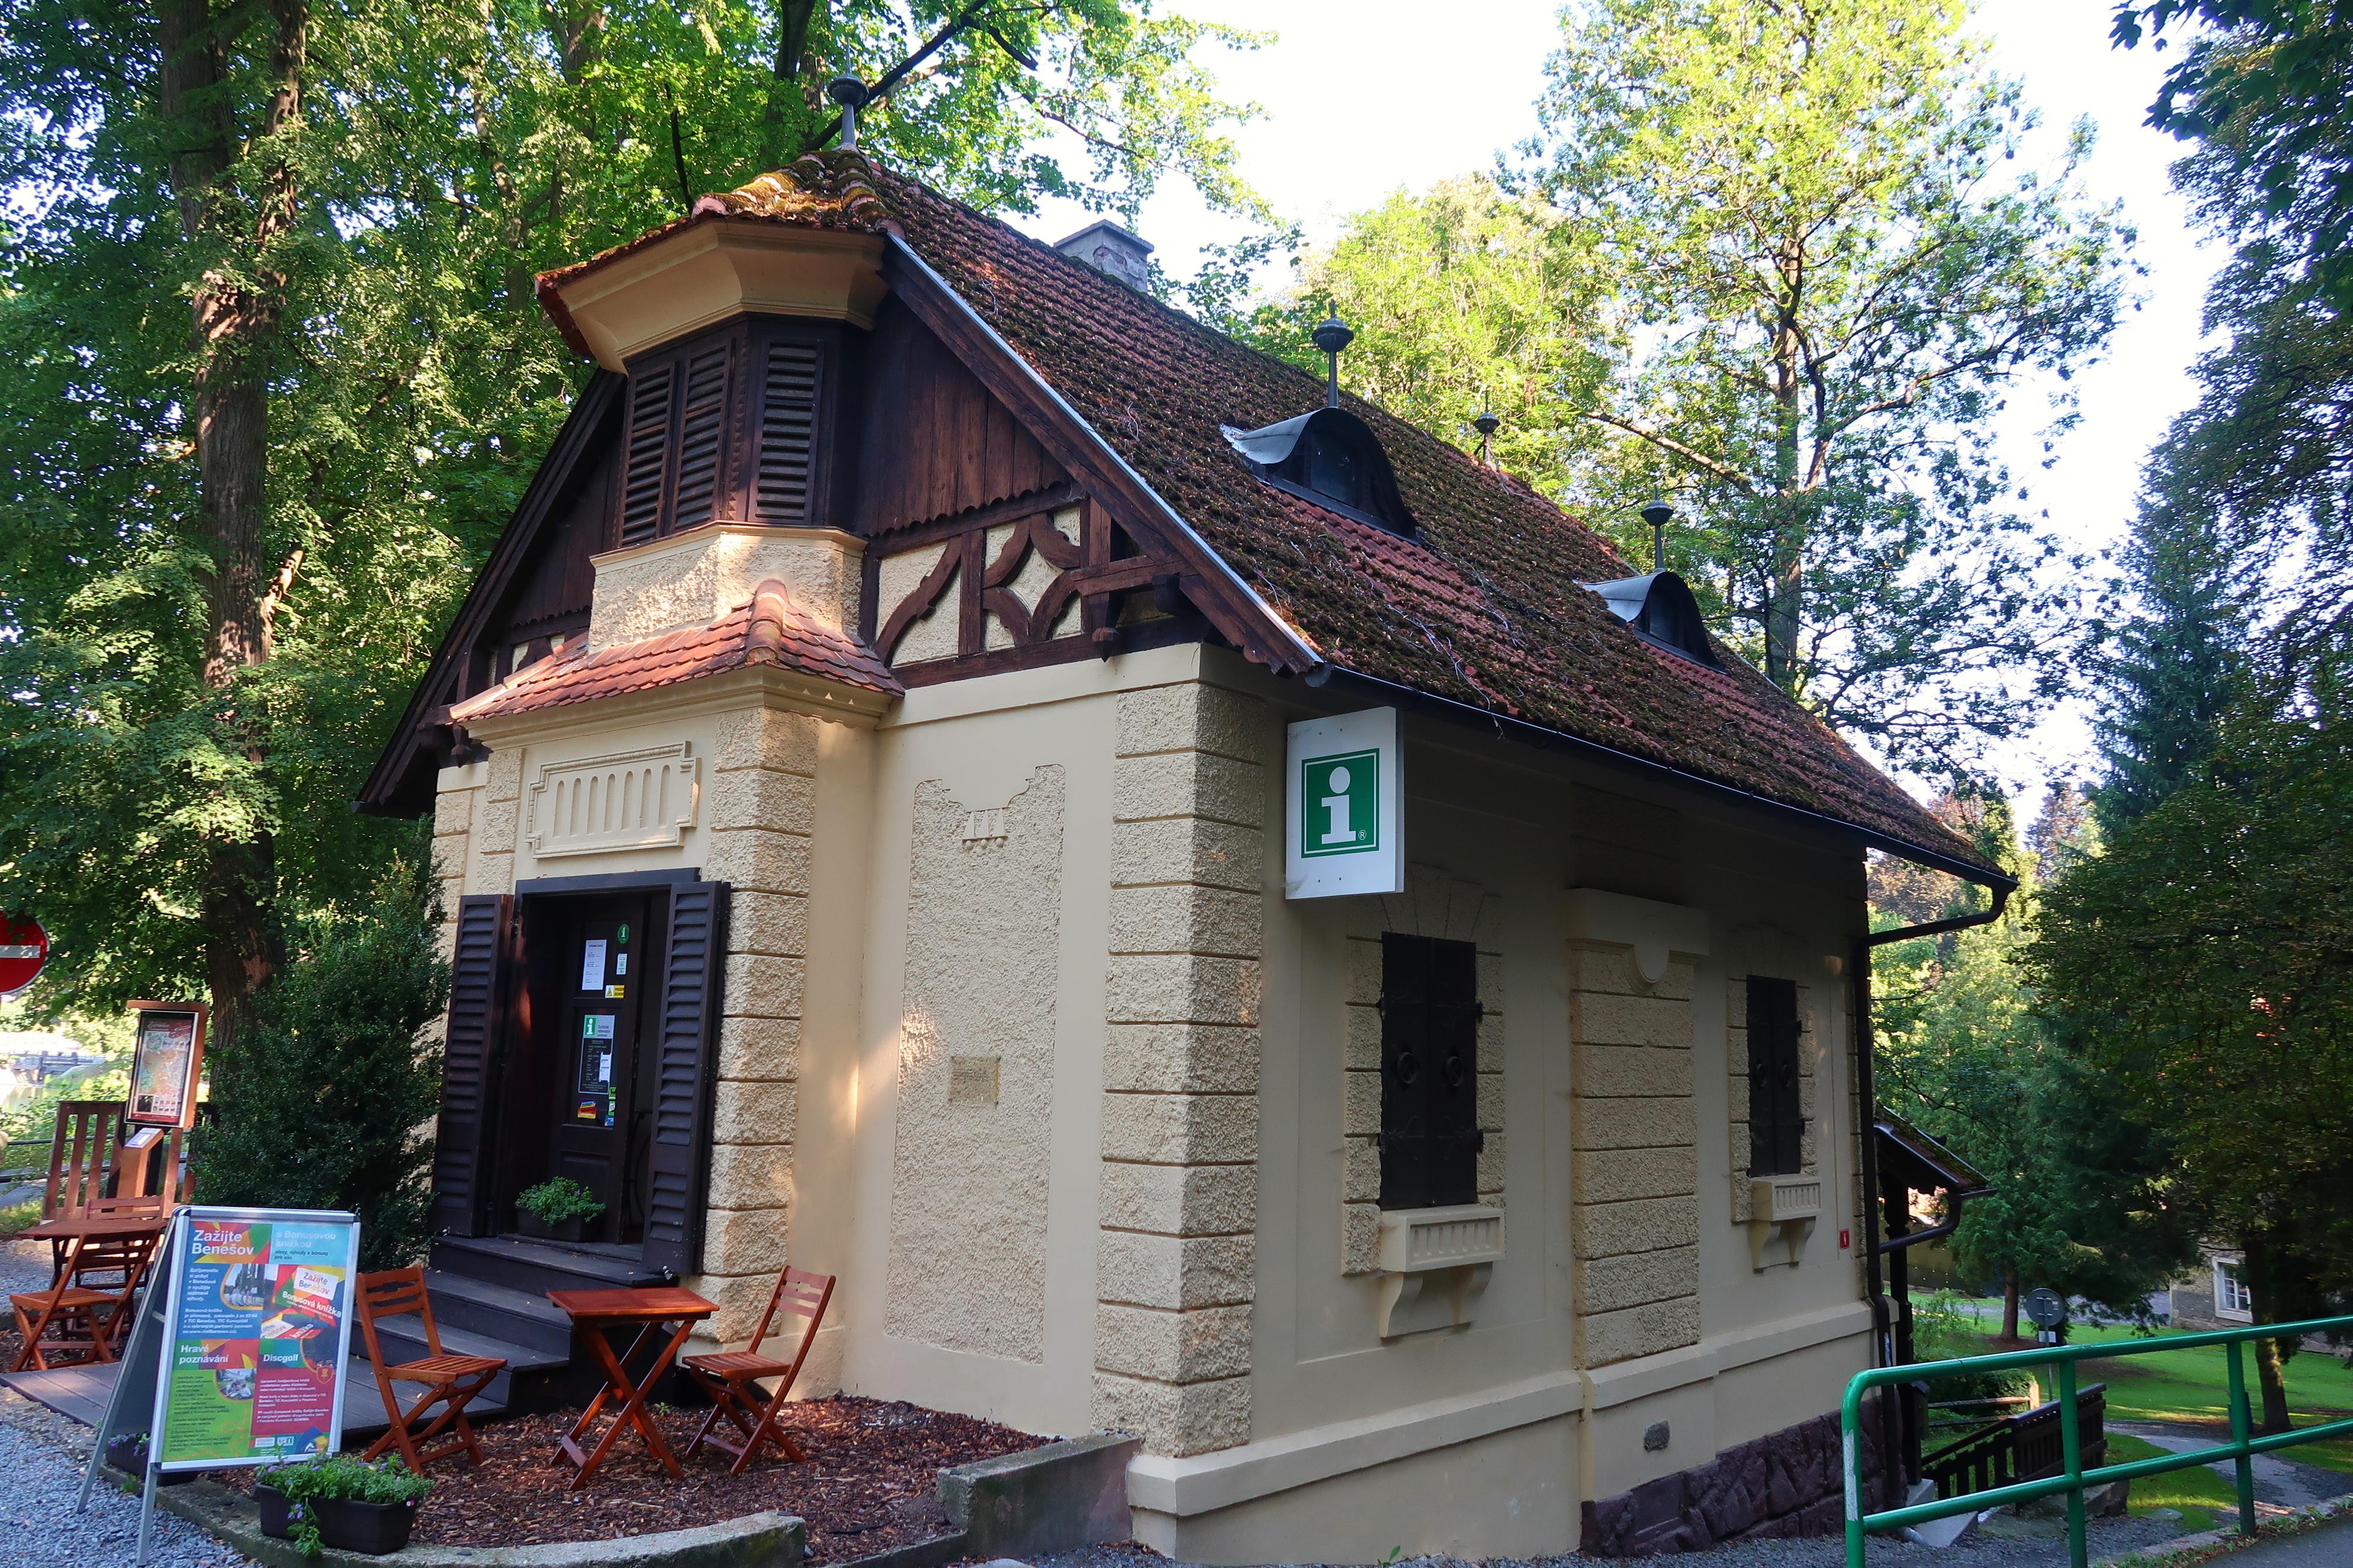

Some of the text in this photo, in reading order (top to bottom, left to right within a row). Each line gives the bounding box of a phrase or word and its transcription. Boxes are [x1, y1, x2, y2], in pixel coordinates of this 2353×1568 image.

[193, 1229, 242, 1244] Zažijte
[285, 1230, 336, 1239] Bonusovou
[275, 1239, 312, 1247] knížkou
[192, 1243, 254, 1255] Benešov
[304, 1272, 328, 1285] Zažijte
[299, 1280, 329, 1294] Benešov
[282, 1290, 316, 1307] Bonusová
[316, 1302, 342, 1317] knížka
[181, 1344, 210, 1353] Hravé
[179, 1354, 229, 1365] poznávání
[263, 1354, 299, 1363] Discgolf
